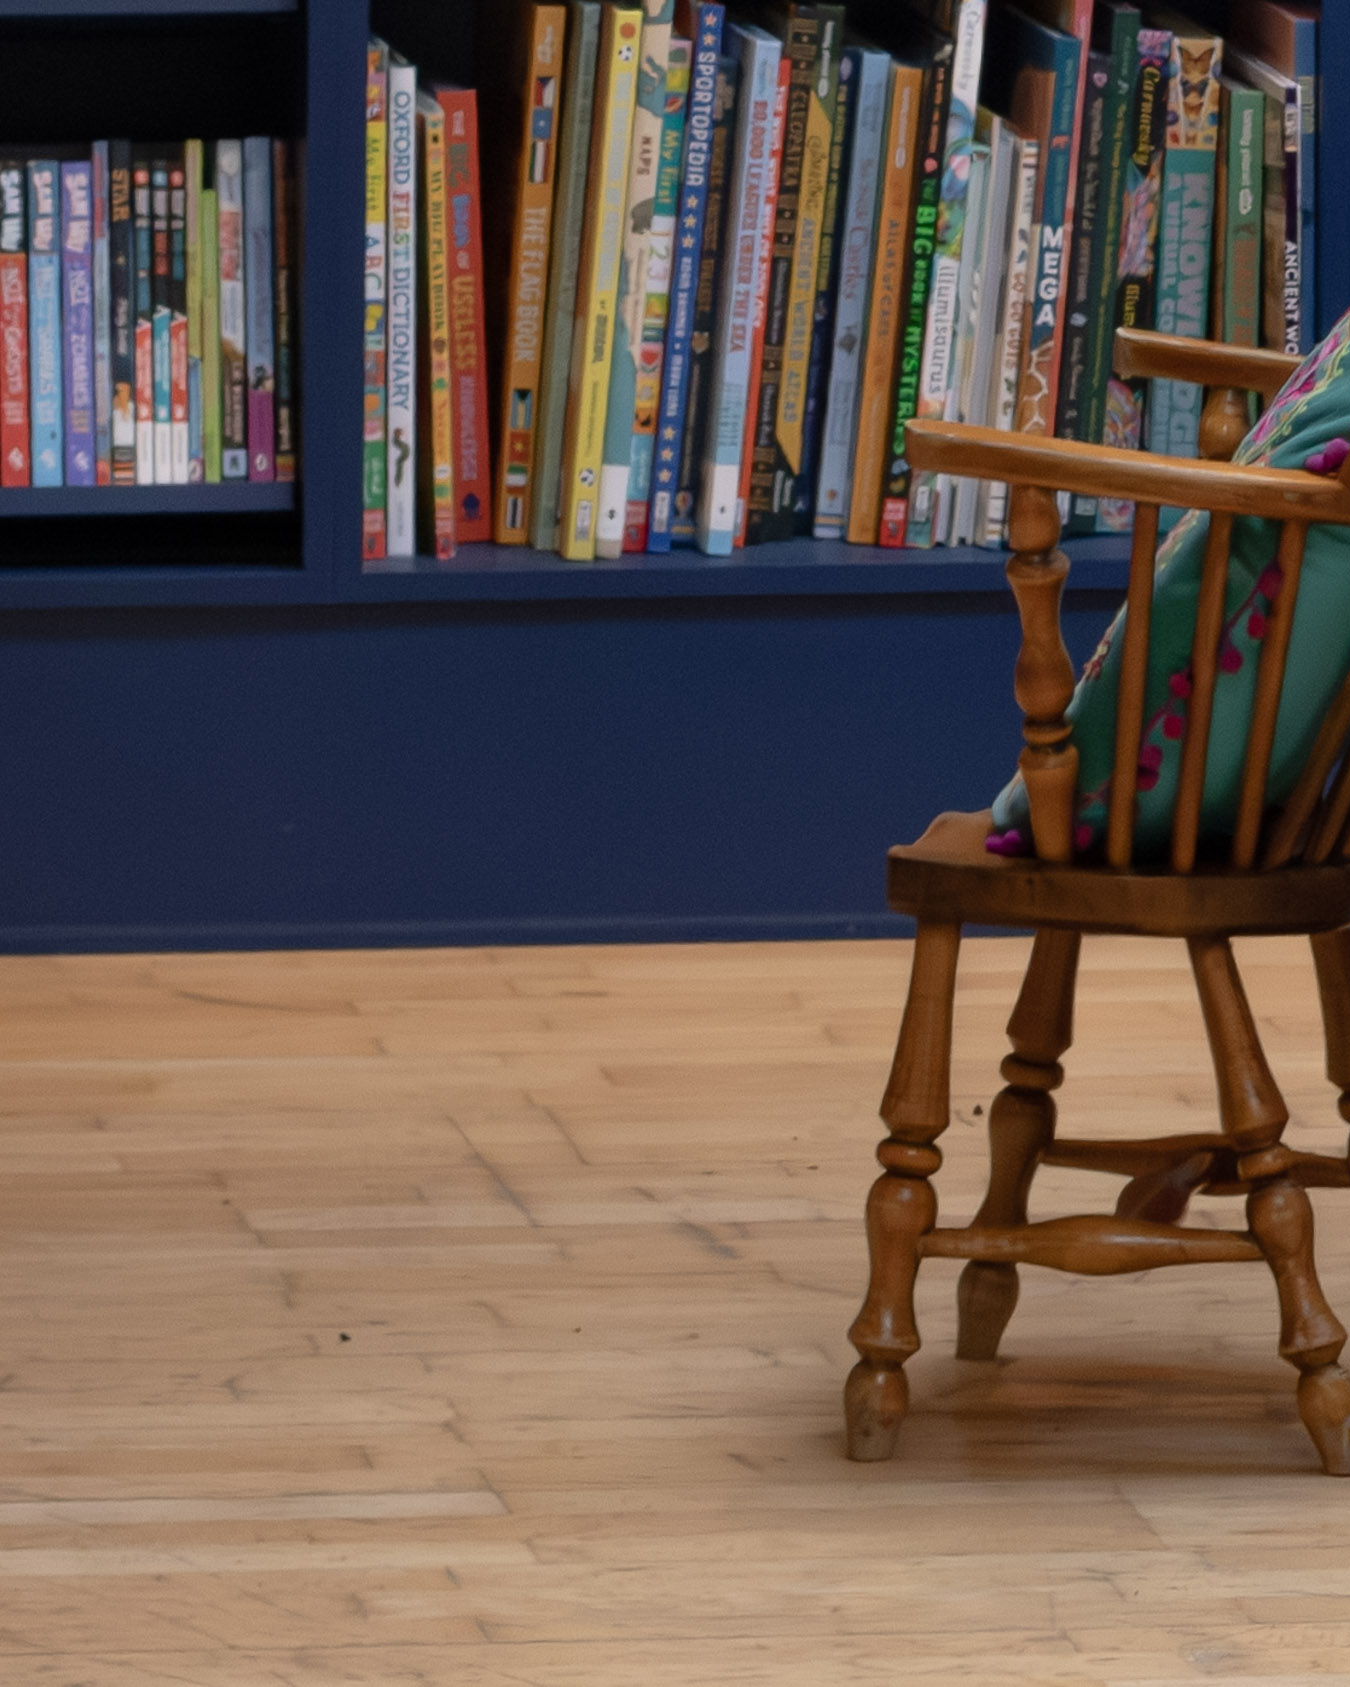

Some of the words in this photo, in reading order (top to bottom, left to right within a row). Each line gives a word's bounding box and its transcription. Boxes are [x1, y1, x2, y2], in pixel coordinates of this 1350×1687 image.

[393, 90, 412, 185] OXFORD
[662, 130, 679, 160] My
[686, 51, 716, 187] SPORTOPEDIA
[784, 91, 807, 187] CLEOPATRA
[636, 136, 653, 176] MAPS
[658, 168, 676, 204] first
[393, 191, 411, 263] FIRST
[523, 207, 547, 245] THE
[742, 163, 762, 231] LEAGUES
[736, 235, 755, 285] UNDER
[913, 204, 937, 255] BIG
[1161, 202, 1181, 290] VISUAL
[518, 250, 544, 301] FLAG
[733, 289, 751, 320] THE
[1284, 241, 1300, 322] ANCIENT
[390, 266, 415, 410] DICTIONARY
[451, 274, 478, 370] USELESS
[515, 304, 539, 363] BOOK
[729, 323, 747, 354] SEA
[928, 264, 955, 395] illumisaurus
